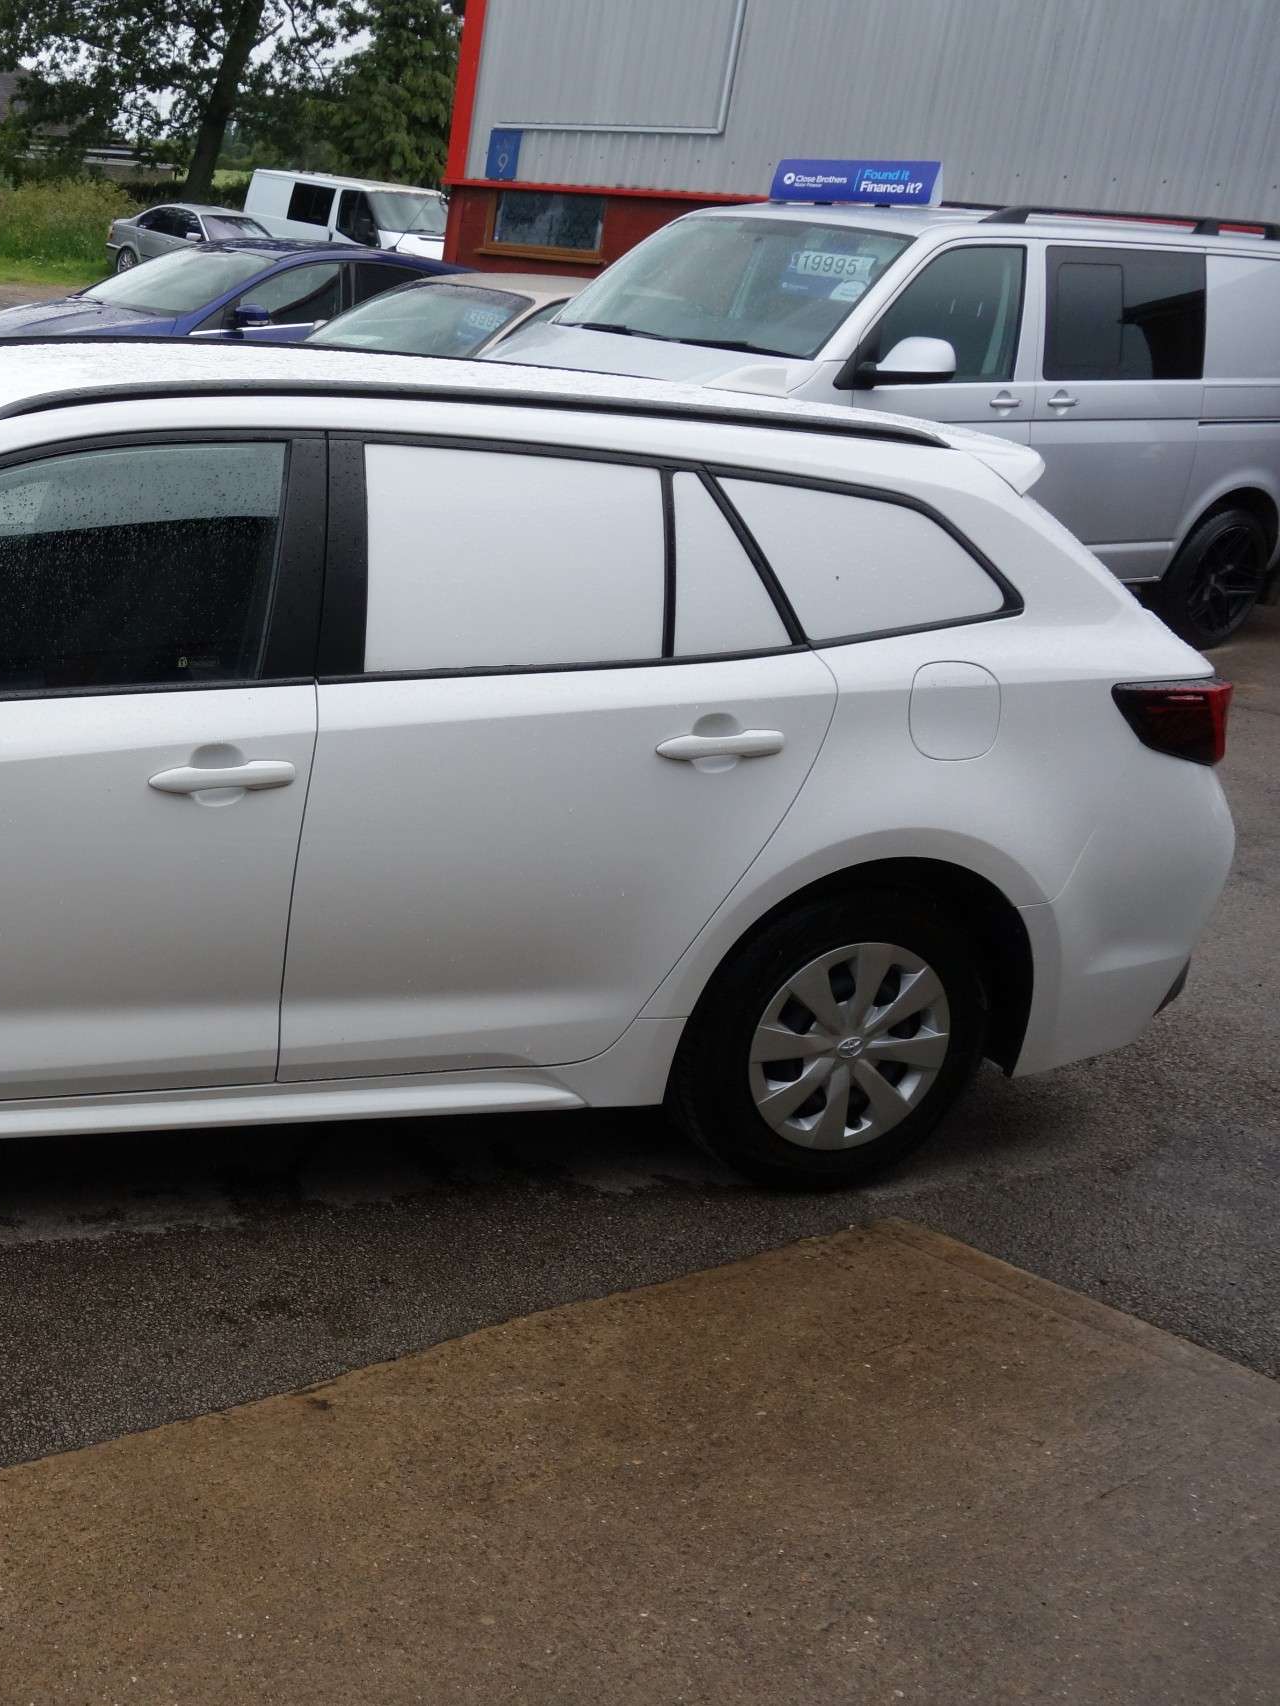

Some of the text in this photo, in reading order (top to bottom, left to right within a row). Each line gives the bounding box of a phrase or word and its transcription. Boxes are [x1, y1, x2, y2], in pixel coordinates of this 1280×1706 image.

[795, 174, 848, 184] Close Brothers
[863, 169, 911, 181] Found it
[859, 181, 923, 194] Finance it?
